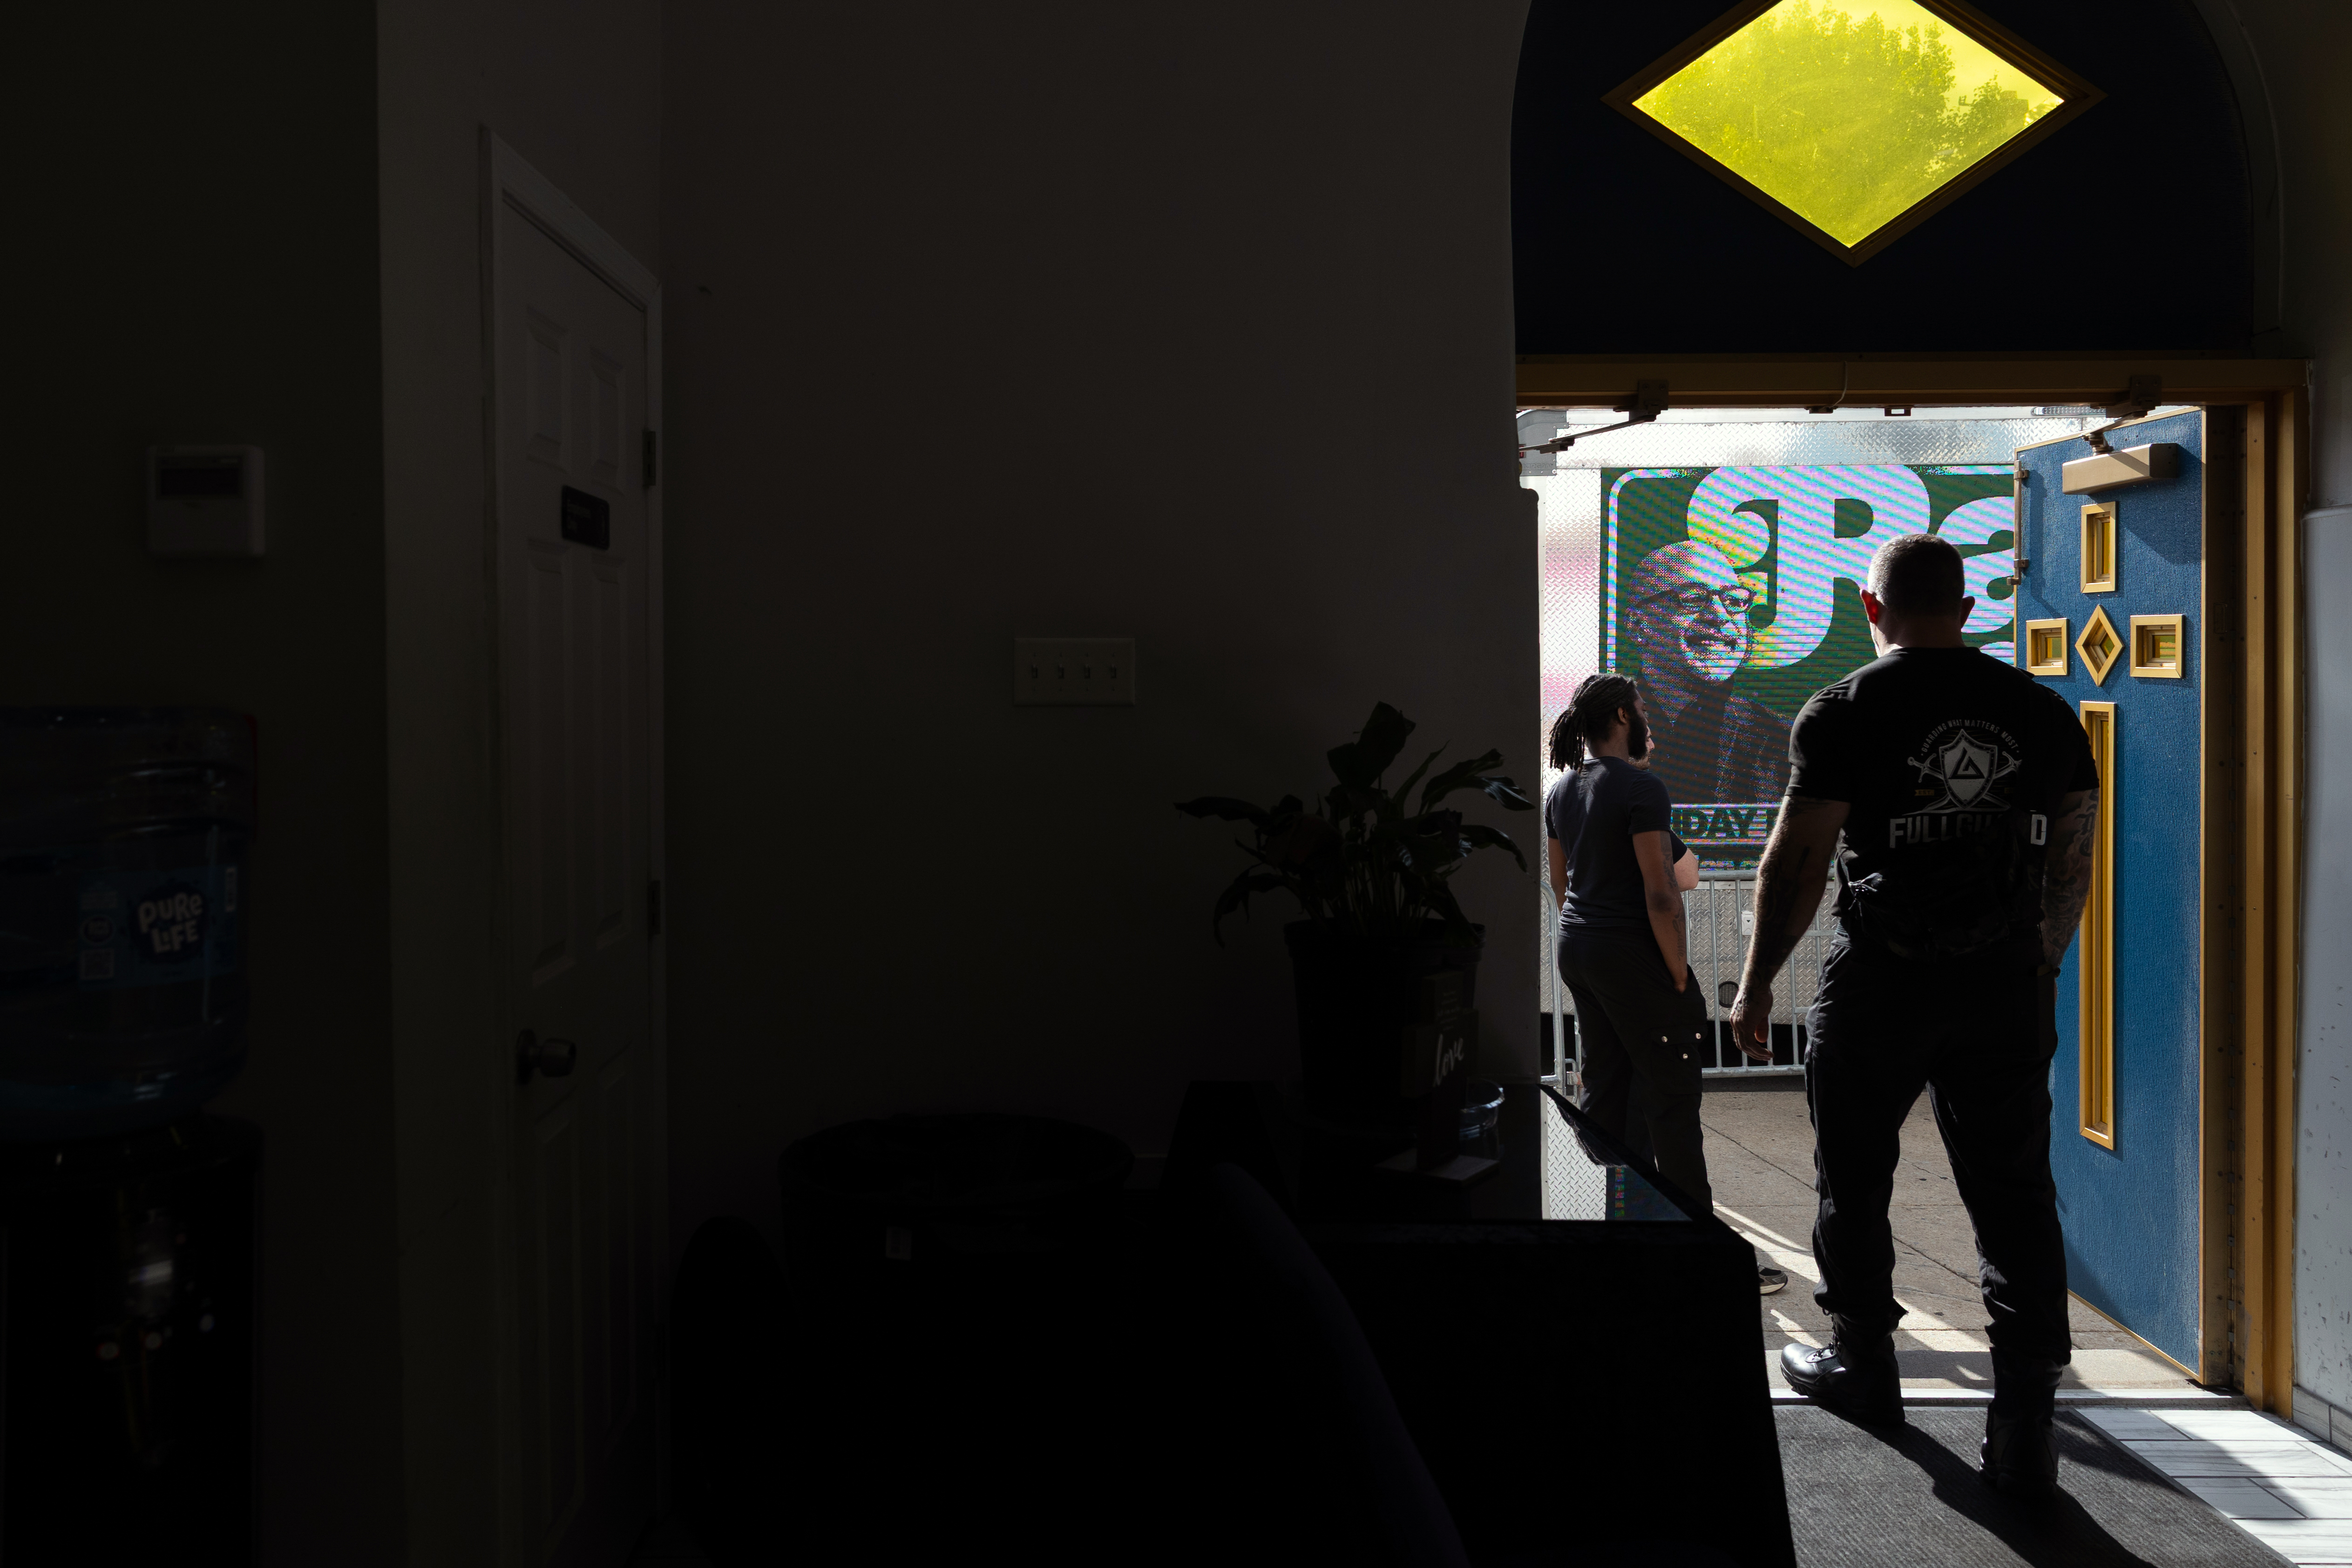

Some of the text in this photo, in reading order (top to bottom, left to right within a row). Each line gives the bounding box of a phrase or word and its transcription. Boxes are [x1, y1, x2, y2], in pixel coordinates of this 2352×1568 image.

[1922, 719, 2019, 753] GUARDING WHAT MATTERS MOST
[1889, 814, 2047, 849] FULLGUD
[1432, 1033, 1464, 1088] love
